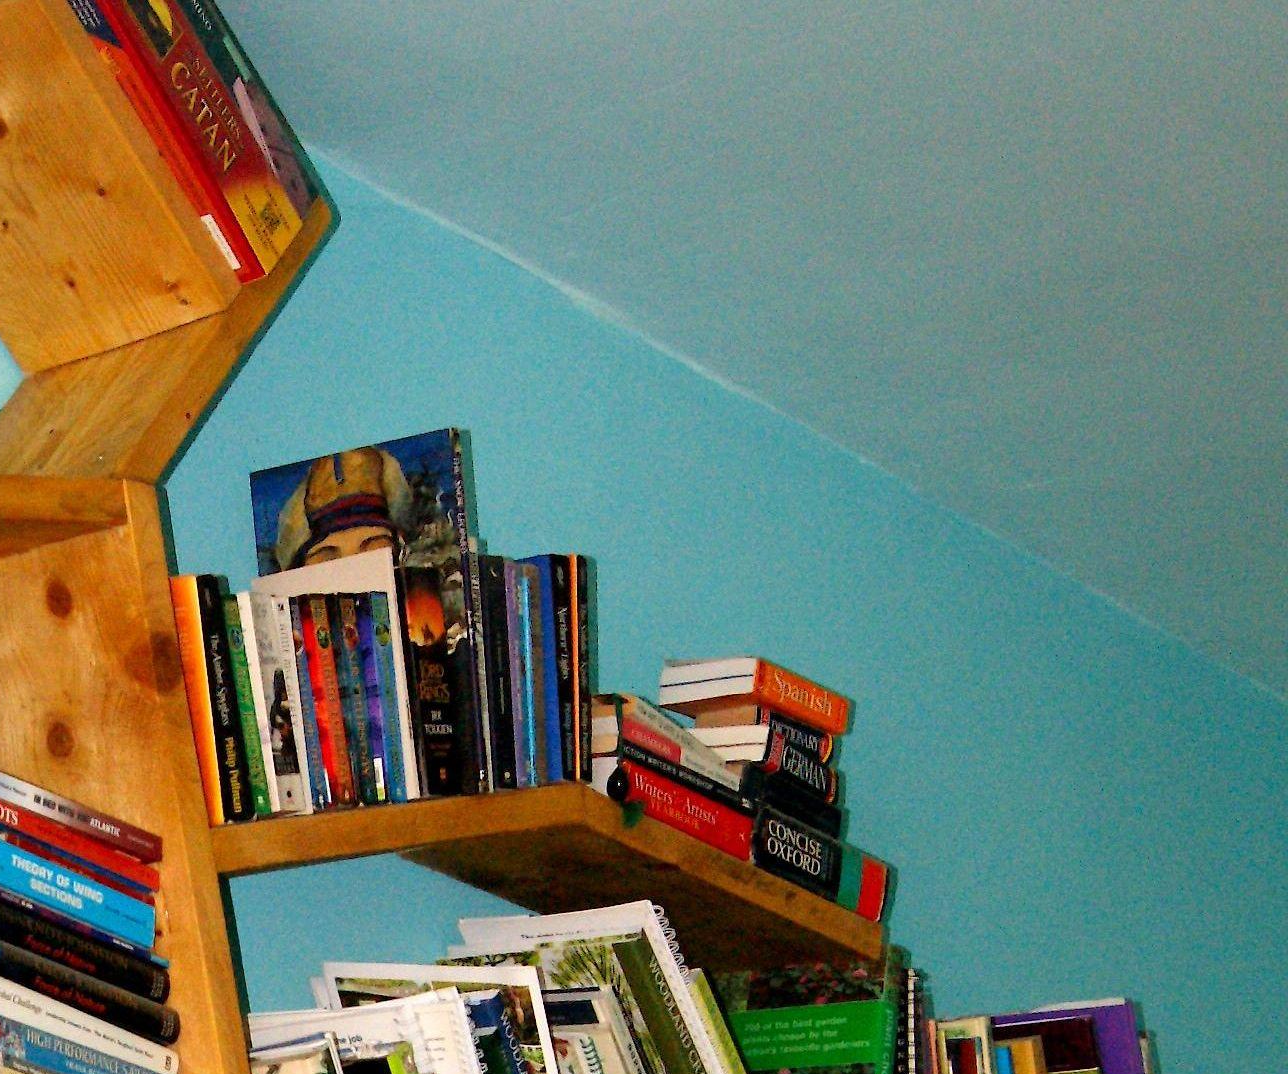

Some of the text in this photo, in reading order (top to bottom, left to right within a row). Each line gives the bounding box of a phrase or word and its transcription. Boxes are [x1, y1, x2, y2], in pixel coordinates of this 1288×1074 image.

[162, 58, 243, 173] CATAN
[773, 670, 832, 718] Spanish
[220, 736, 247, 814] Philip Pullman
[782, 745, 827, 790] GERMAN
[90, 818, 120, 836] ATLANTIC
[767, 818, 823, 859] CONCISE
[11, 855, 104, 902] THEORY OF WING
[766, 836, 821, 876] OXFORD
[31, 879, 83, 909] SECTIONS
[645, 957, 694, 1049] WOODLAND
[27, 1029, 52, 1048] HIGH
[53, 1036, 118, 1073] PERFORMANCE
